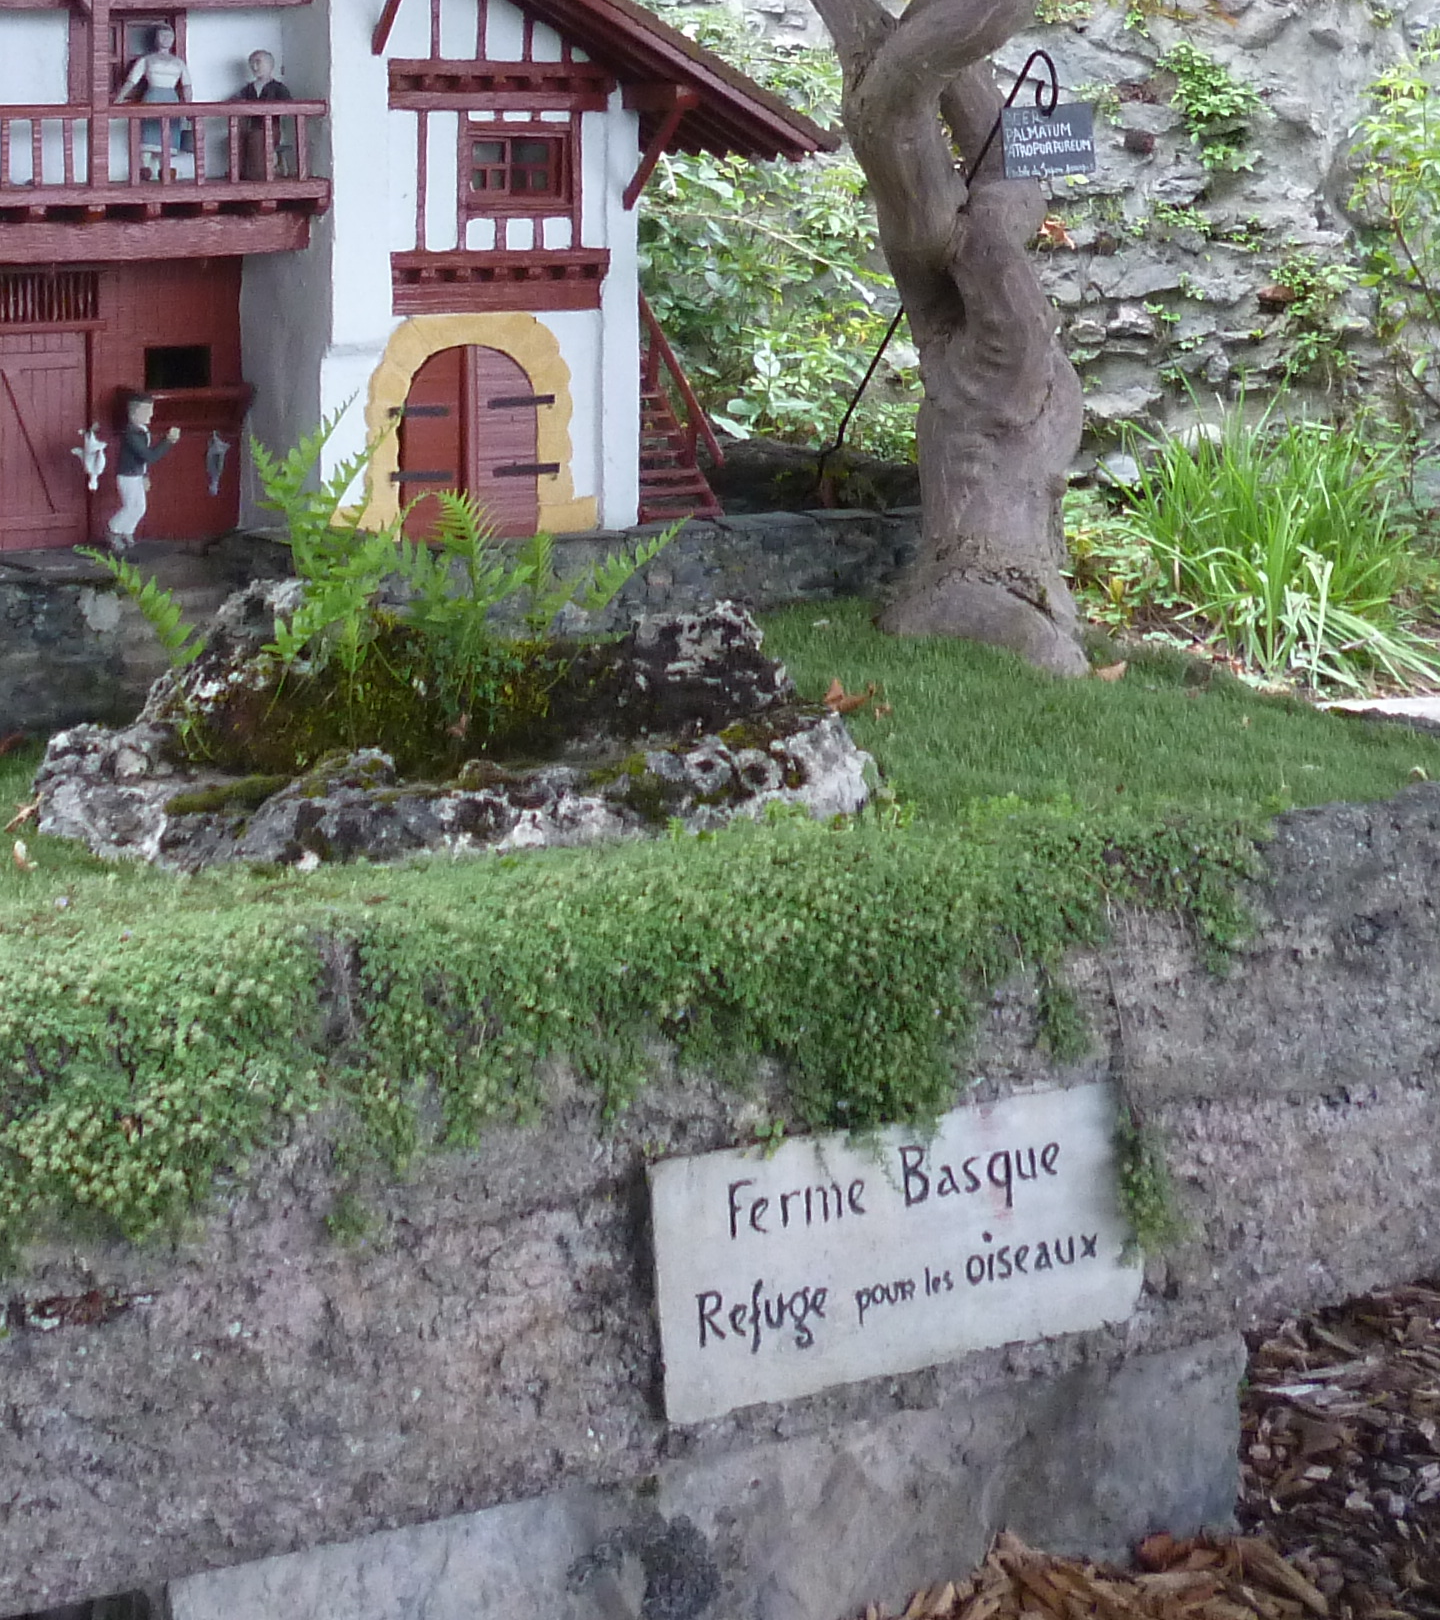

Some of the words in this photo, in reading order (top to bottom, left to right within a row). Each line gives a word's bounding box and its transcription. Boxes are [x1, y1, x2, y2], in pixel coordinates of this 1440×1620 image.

[1006, 122, 1072, 142] PALMATUM
[726, 1178, 866, 1239] Ferme
[898, 1141, 1060, 1208] Basque
[696, 1279, 827, 1354] Refuge
[924, 1267, 954, 1296] les
[965, 1230, 1098, 1284] oiseaux
